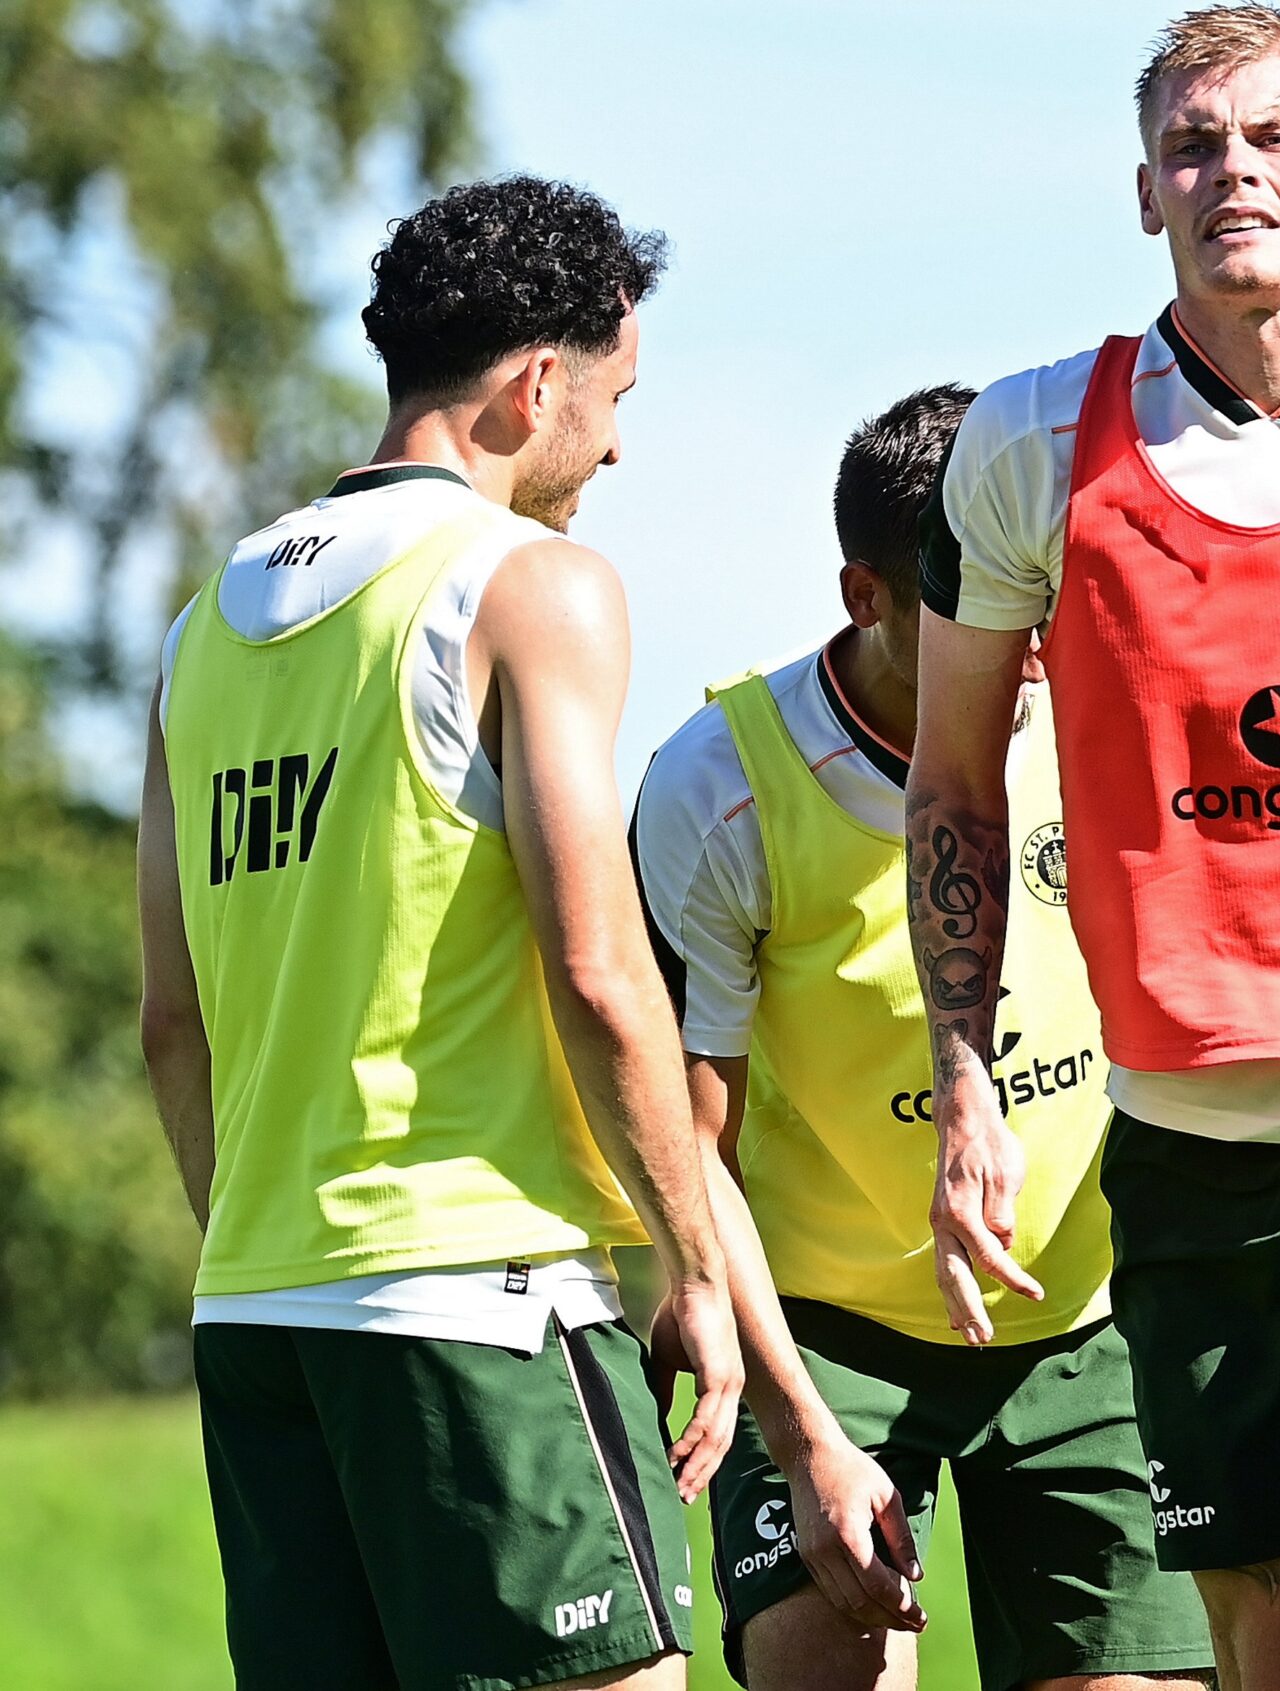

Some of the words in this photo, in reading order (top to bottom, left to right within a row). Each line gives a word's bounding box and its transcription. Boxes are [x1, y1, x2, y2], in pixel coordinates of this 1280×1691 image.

[1024, 854, 1035, 870] FC
[1052, 891, 1067, 903] 19
[890, 1049, 1094, 1124] costar
[734, 1530, 799, 1579] congst
